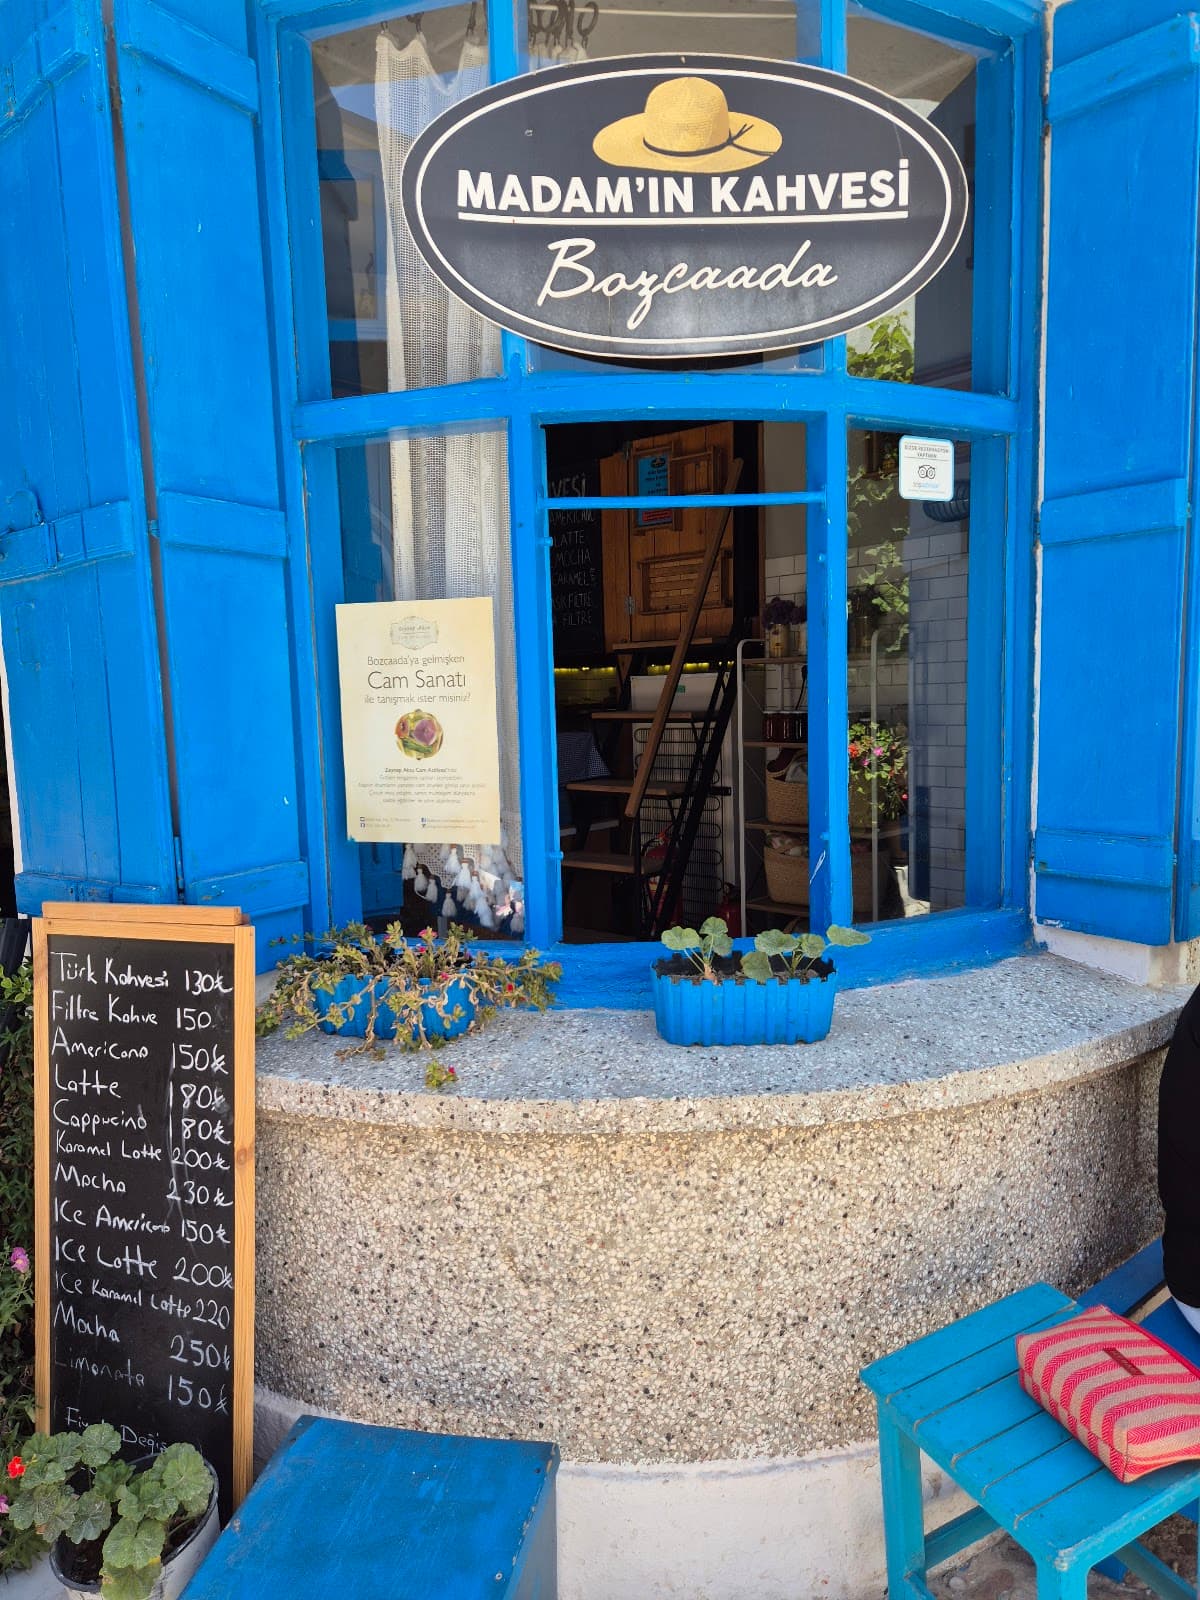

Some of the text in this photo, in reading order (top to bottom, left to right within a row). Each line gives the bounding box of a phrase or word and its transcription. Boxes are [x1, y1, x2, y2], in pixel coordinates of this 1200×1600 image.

[711, 158, 909, 214] KAHVESİ
[536, 237, 838, 330] Bozcaada
[367, 654, 465, 667] Bozcaada'ya gelmişken
[367, 669, 466, 689] Cam Sanatı
[364, 694, 375, 704] ile
[50, 951, 98, 984] Türk
[105, 957, 169, 988] Kahvesi
[52, 989, 99, 1022] Filtre
[108, 993, 158, 1025] Kahve
[55, 1063, 121, 1099] Latte
[56, 1129, 111, 1157] Karamel
[122, 1139, 162, 1161] Latte
[54, 1162, 126, 1193] Mocha
[96, 1245, 158, 1279] Latte
[150, 1294, 192, 1319] Latte
